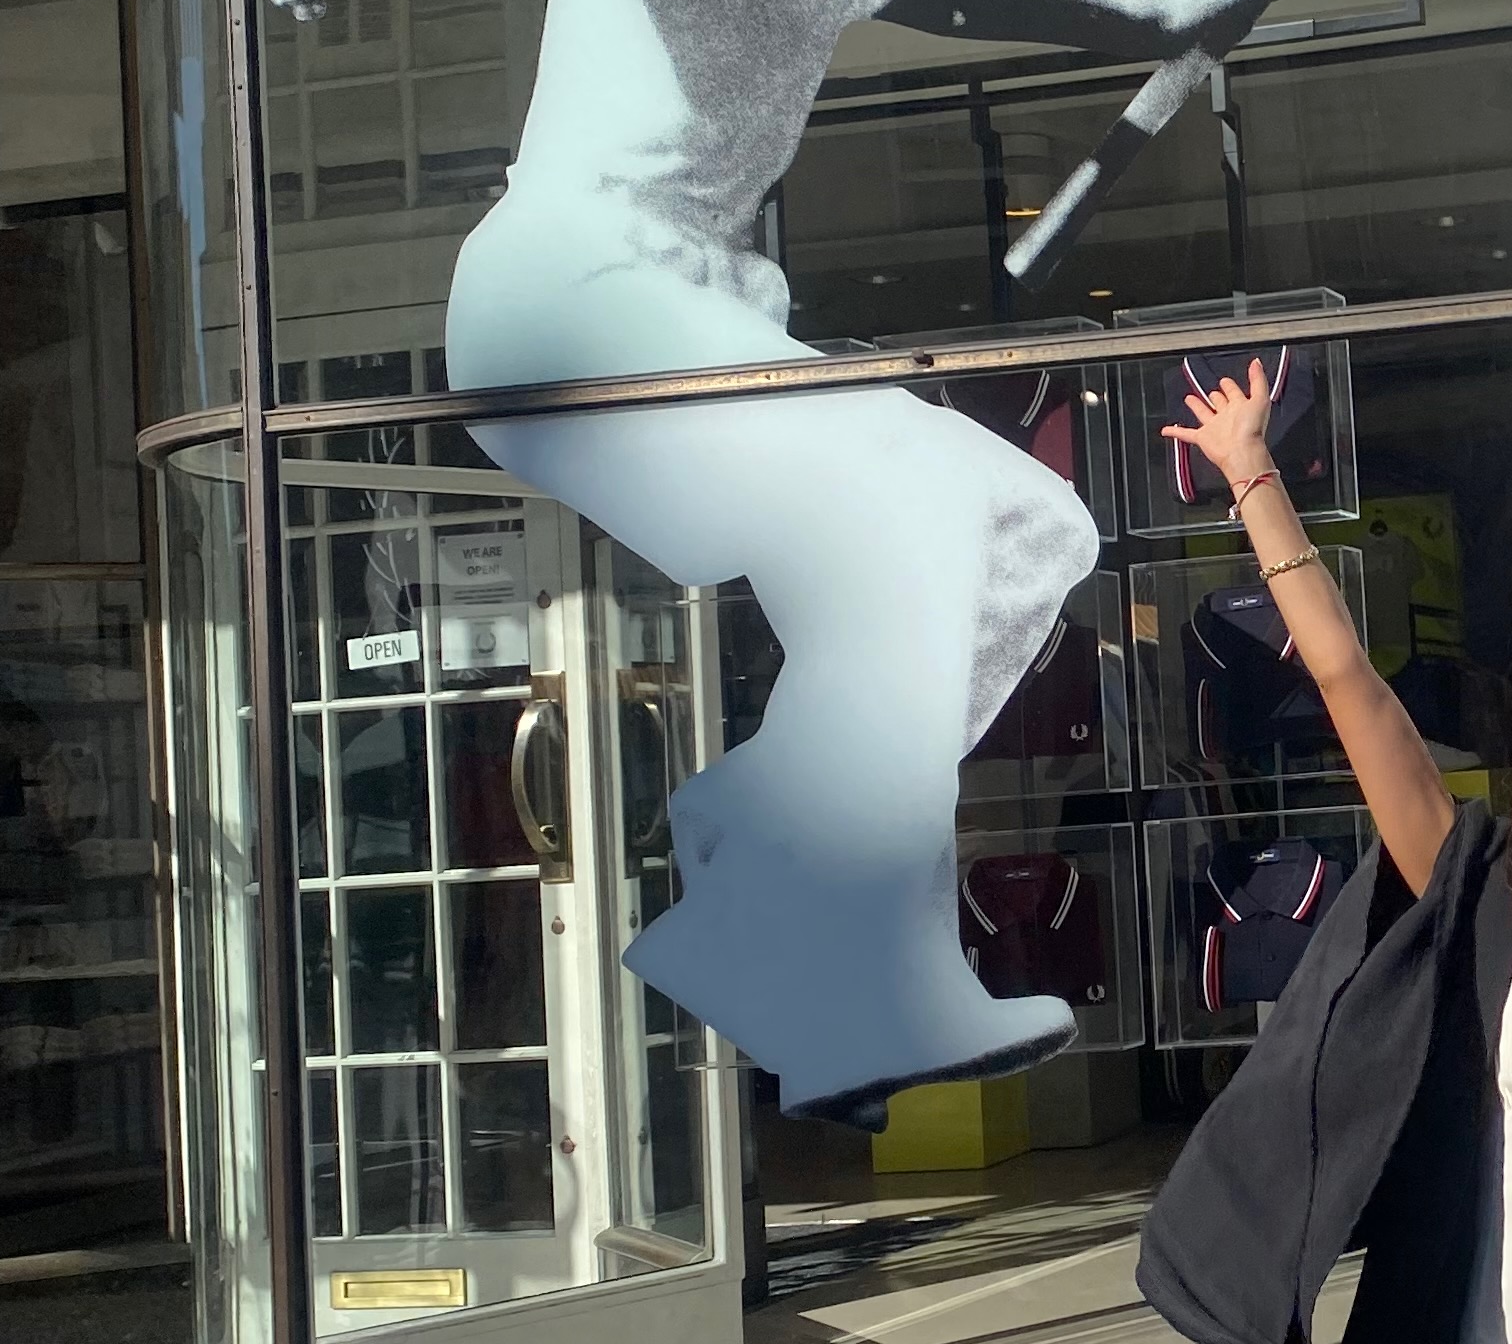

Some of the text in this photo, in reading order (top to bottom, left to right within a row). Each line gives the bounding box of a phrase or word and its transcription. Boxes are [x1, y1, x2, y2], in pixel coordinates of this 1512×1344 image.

[463, 545, 502, 559] WE ARE
[363, 638, 402, 661] OPEN
